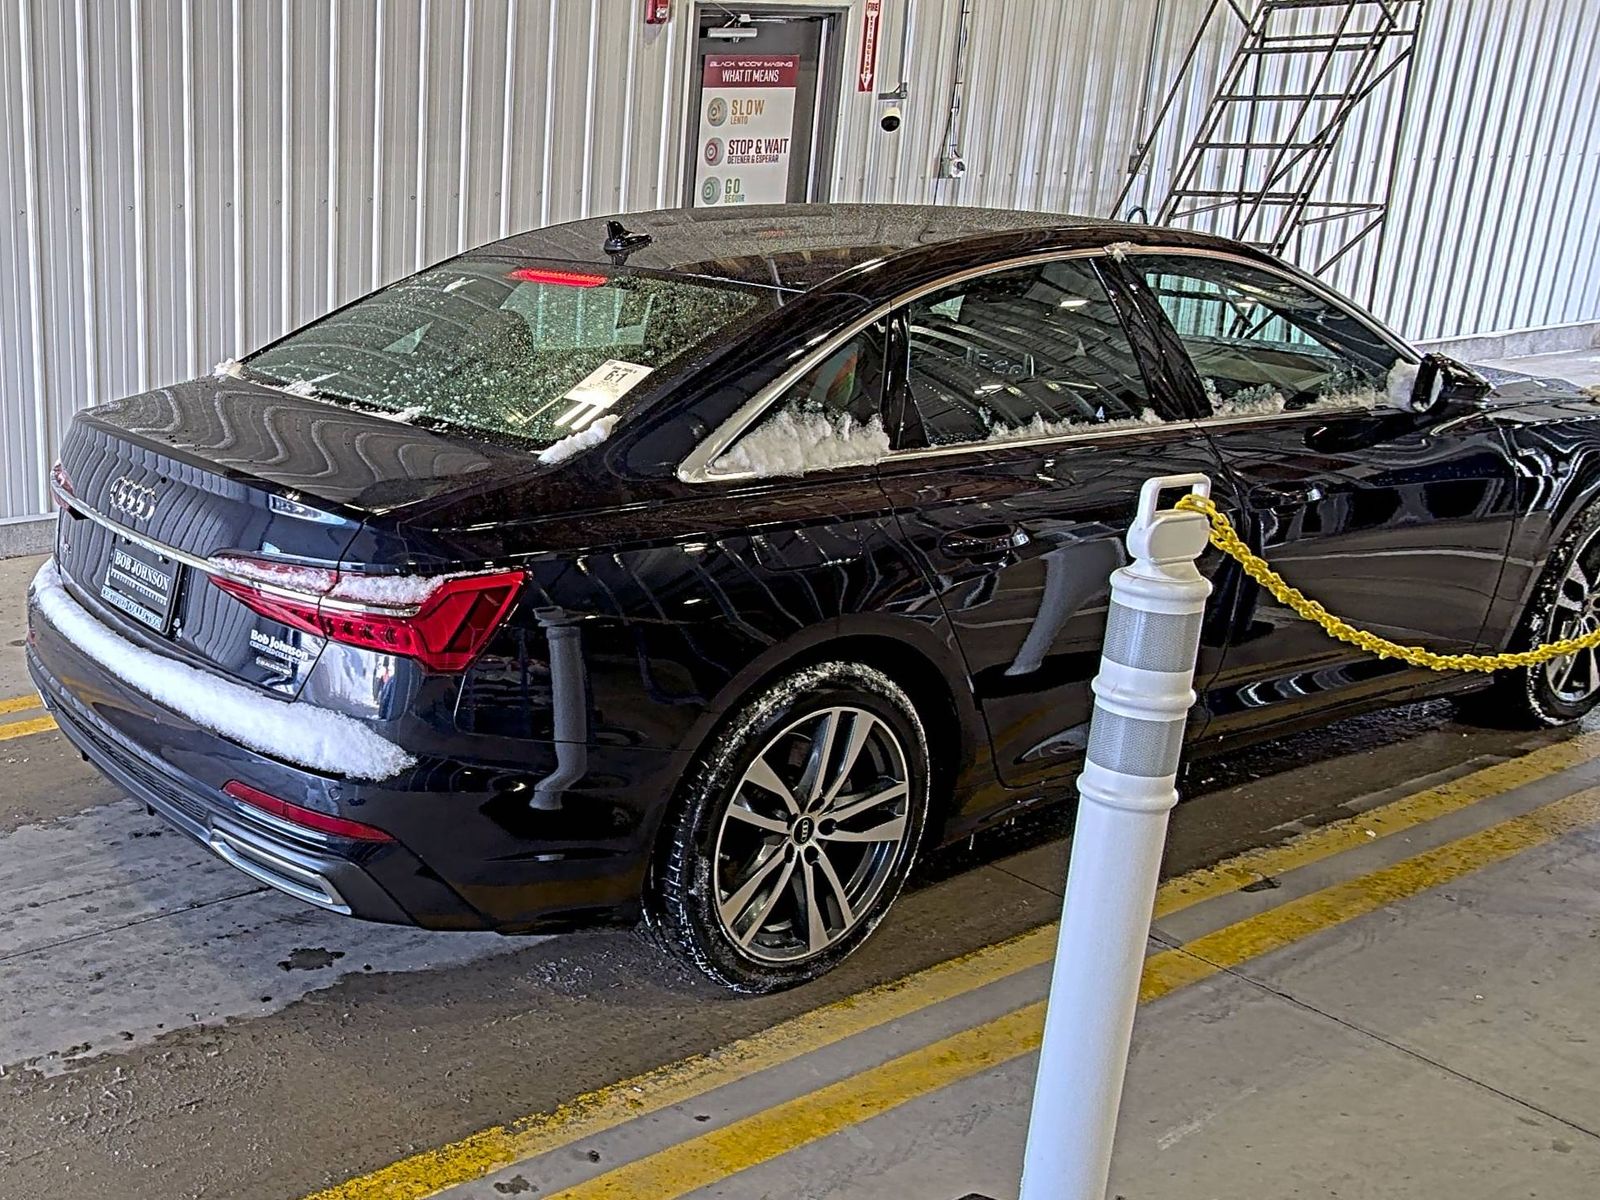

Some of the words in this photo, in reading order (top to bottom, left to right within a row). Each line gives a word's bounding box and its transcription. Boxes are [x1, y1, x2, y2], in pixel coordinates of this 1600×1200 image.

[868, 2, 879, 12] FIRE
[722, 69, 743, 82] WHAT
[744, 69, 752, 82] IT
[752, 69, 780, 82] MEANS
[731, 99, 765, 116] SLOW
[730, 115, 748, 125] LENTO
[728, 139, 754, 155] STOP
[755, 139, 762, 154] &
[764, 138, 789, 154] WAIT
[727, 155, 750, 165] DETENER
[751, 155, 755, 164] &
[756, 154, 779, 164] ESPERAR
[725, 178, 741, 194] GO
[114, 551, 132, 571] BOB
[131, 561, 170, 591] JOHNSON
[250, 629, 270, 646] Bob
[269, 636, 309, 661] Johnson
